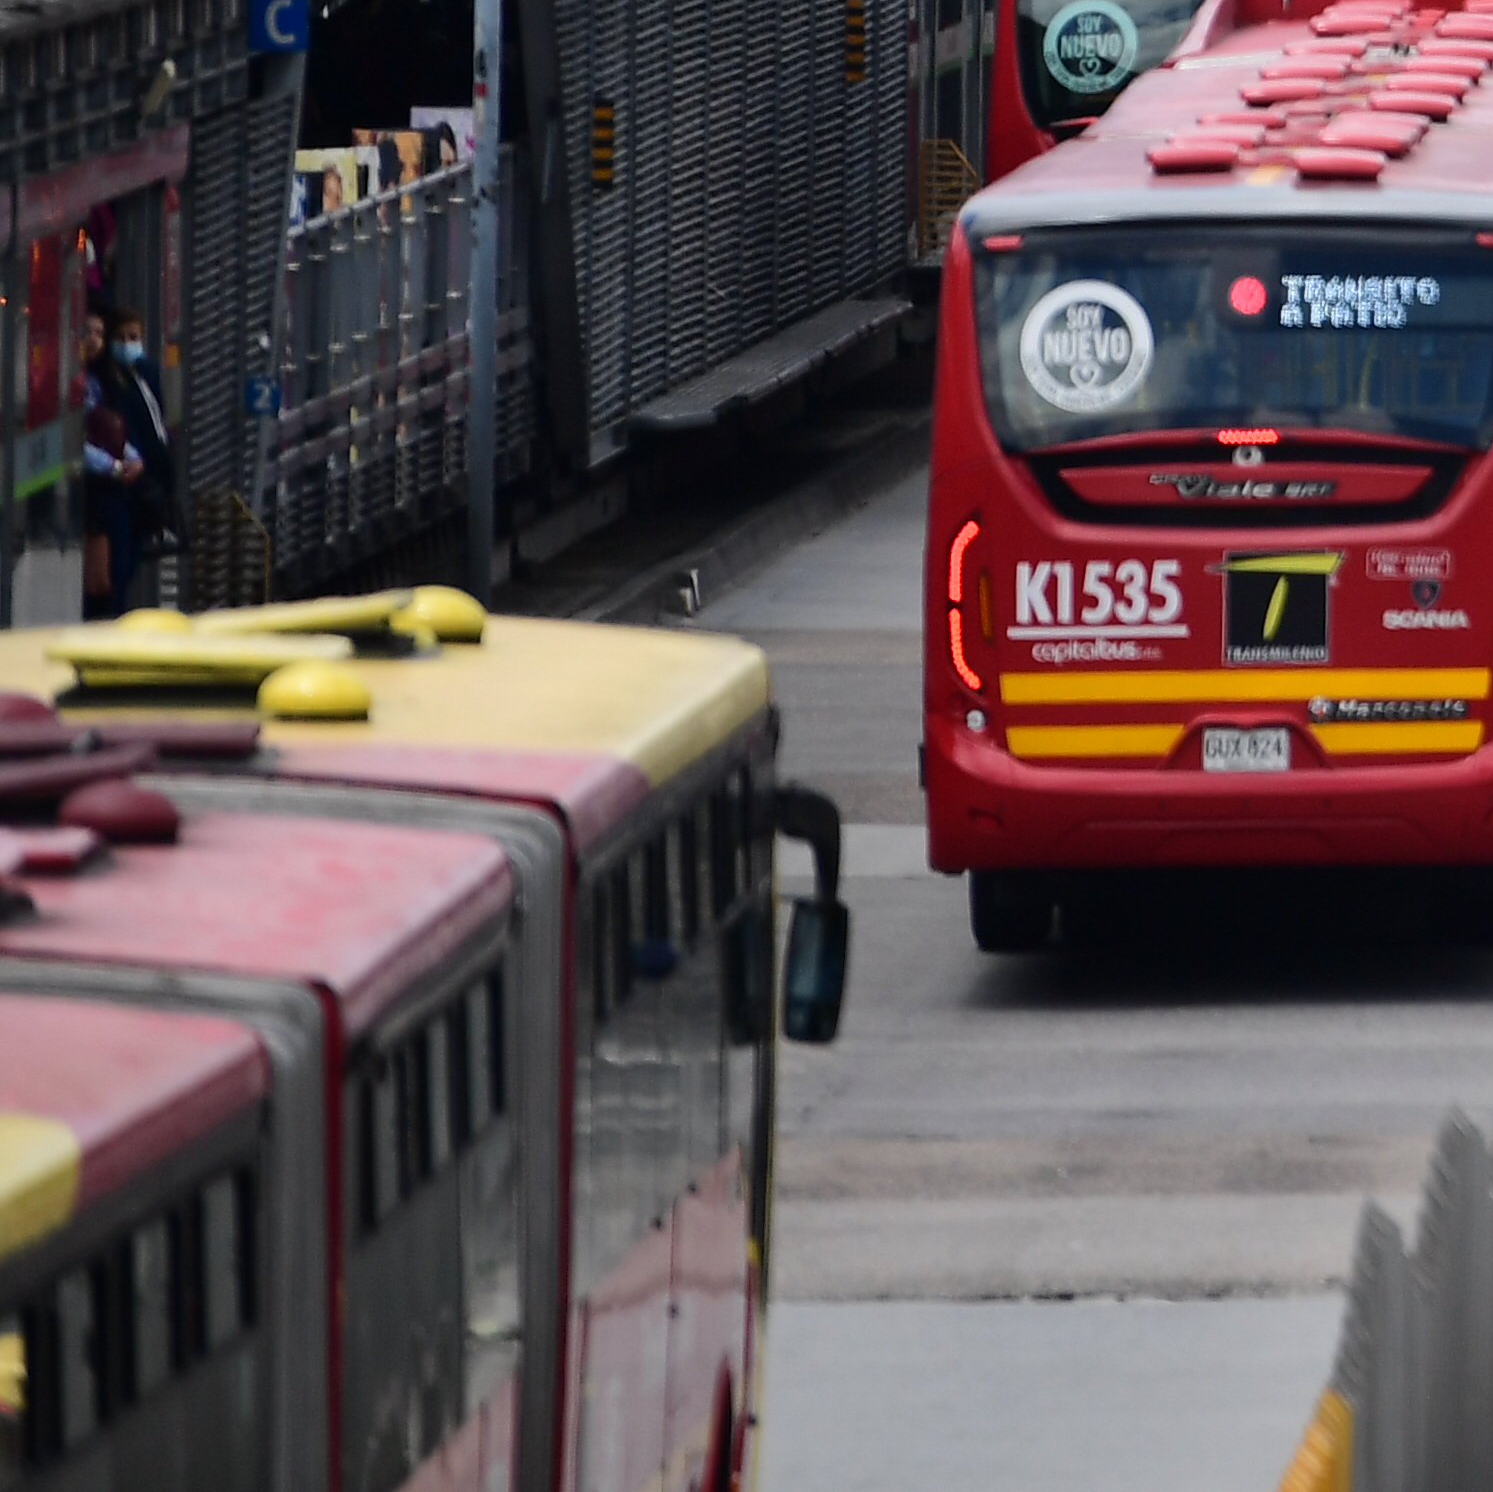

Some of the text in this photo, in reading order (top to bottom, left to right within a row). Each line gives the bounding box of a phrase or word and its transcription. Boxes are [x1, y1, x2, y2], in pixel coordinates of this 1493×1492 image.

[1077, 14, 1101, 33] SOY
[1060, 33, 1122, 60] NUEVO
[1066, 303, 1102, 330] SOY
[1042, 328, 1127, 367] NUEVO
[1014, 559, 1184, 626] K1535
[1382, 610, 1470, 629] SCANIA
[1031, 637, 1138, 665] capitalbus
[1226, 645, 1327, 662] TRANSMILENIO
